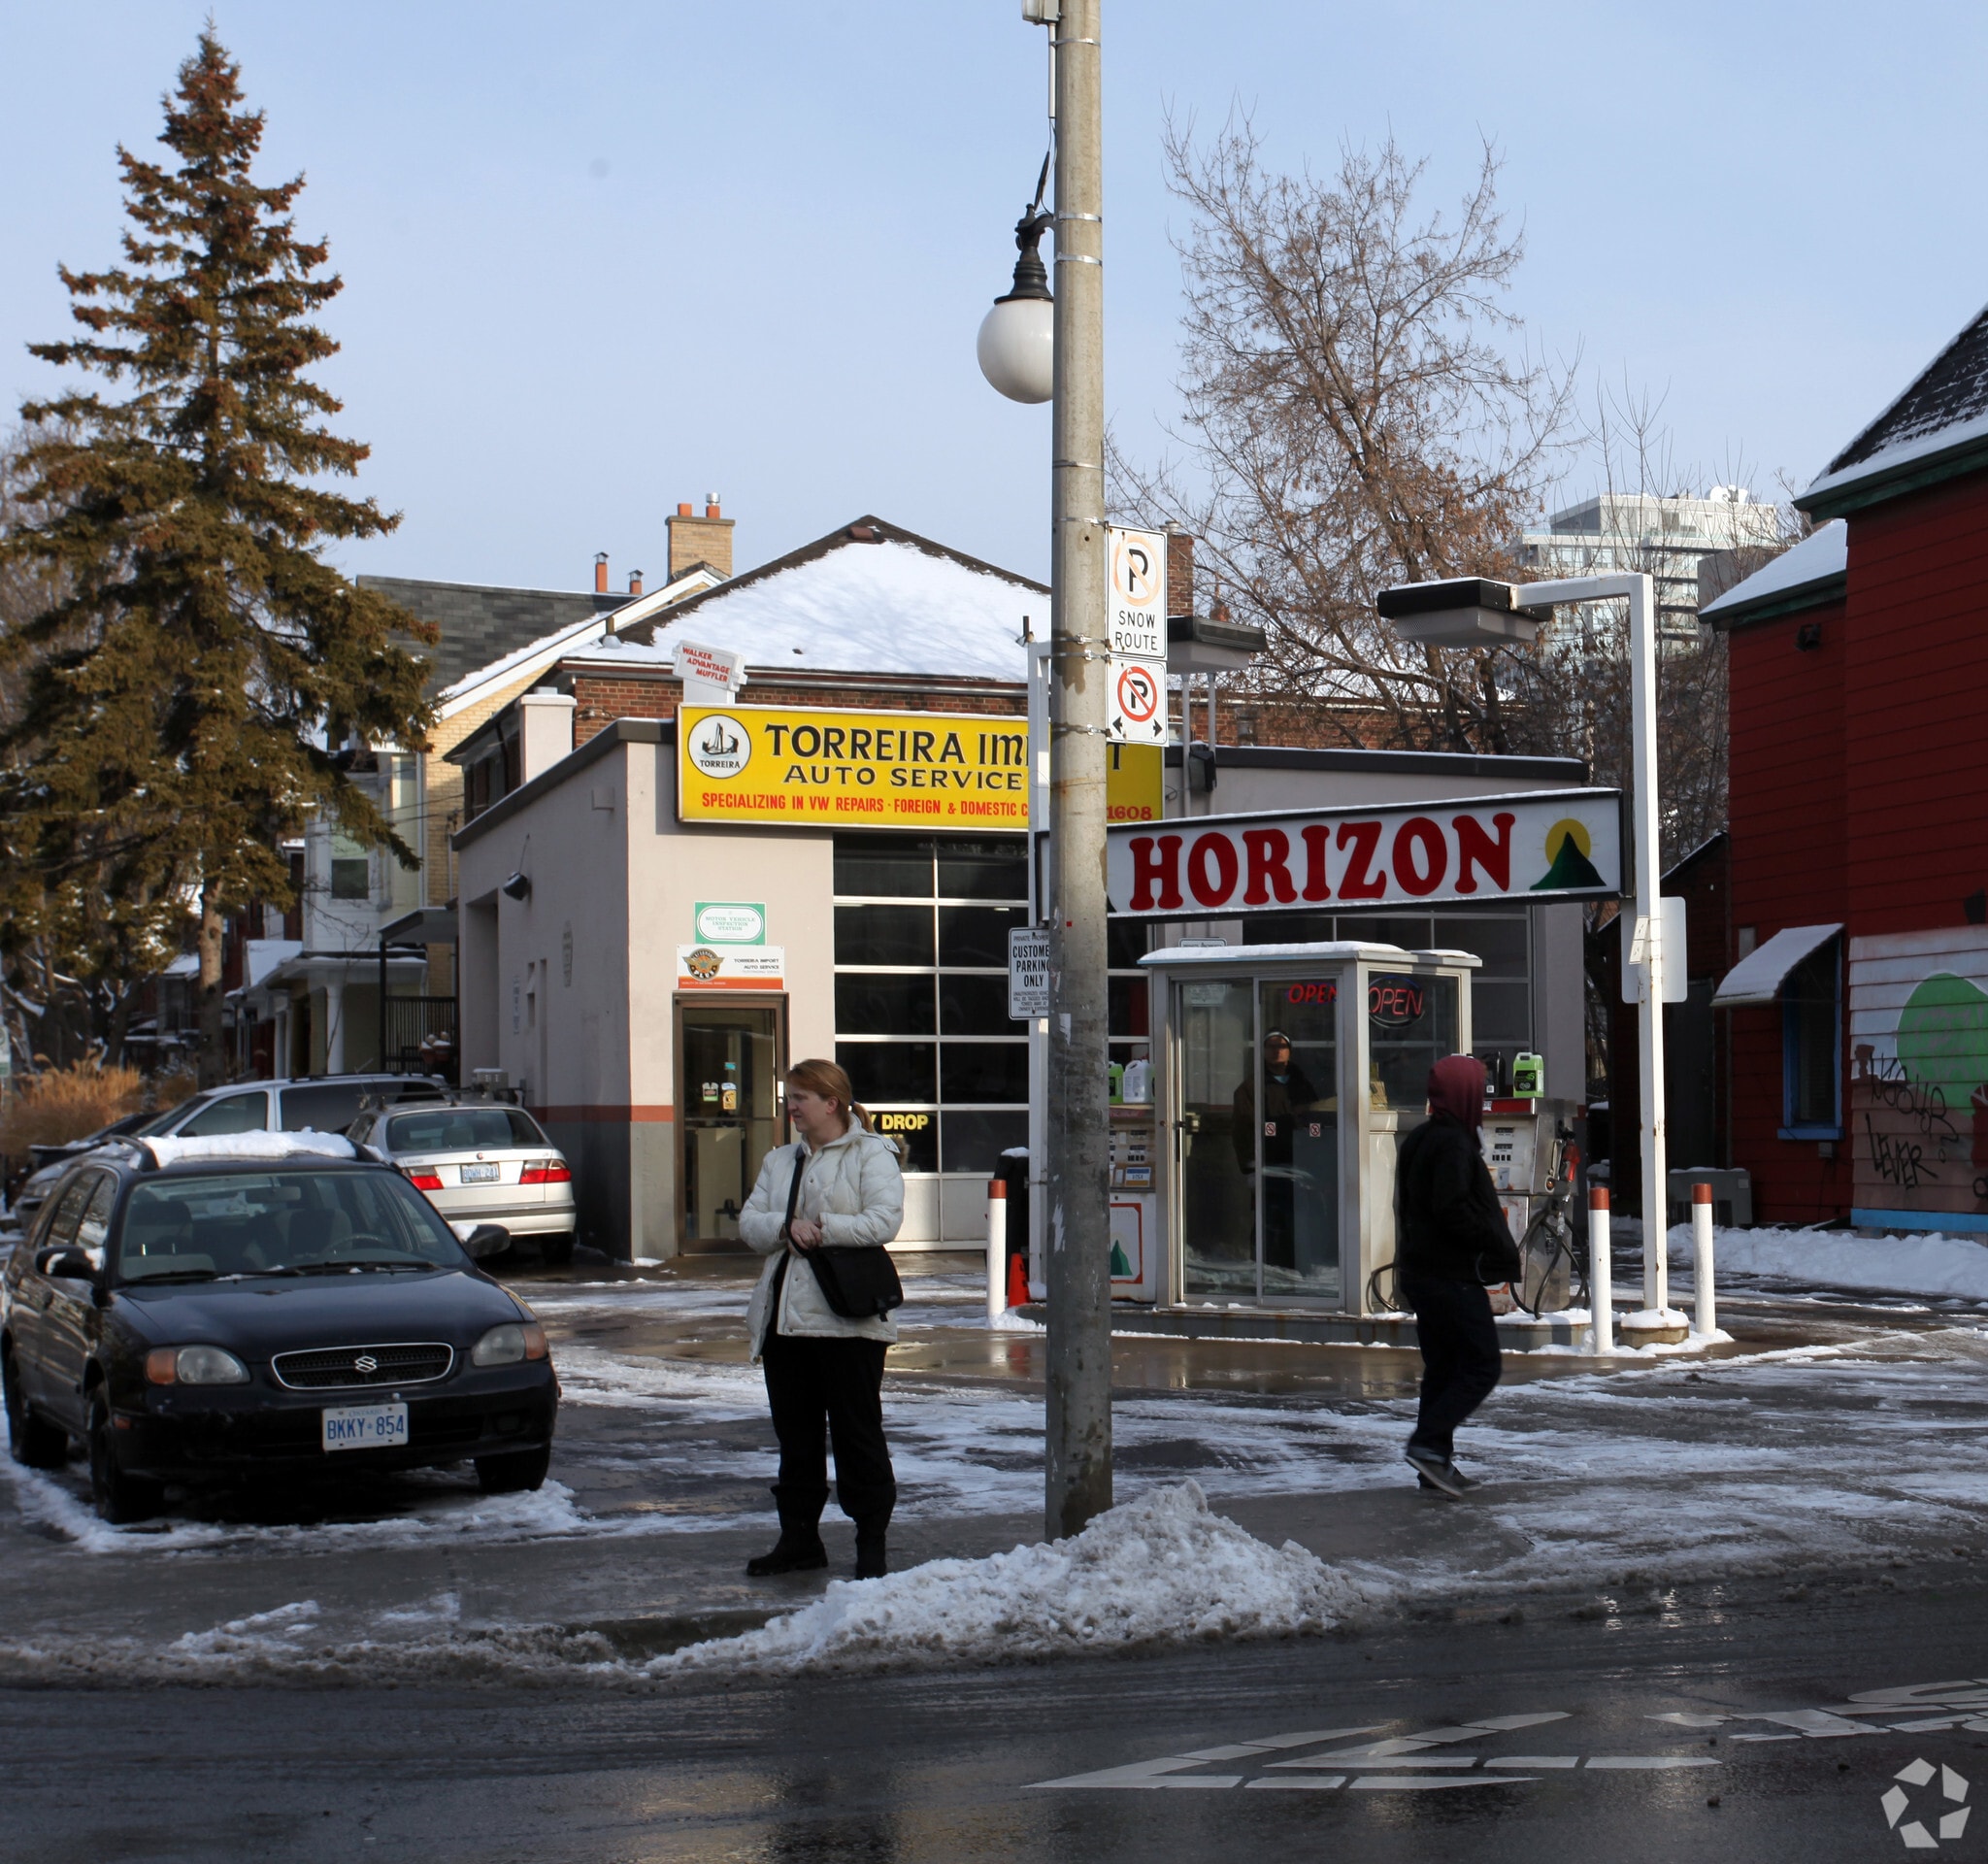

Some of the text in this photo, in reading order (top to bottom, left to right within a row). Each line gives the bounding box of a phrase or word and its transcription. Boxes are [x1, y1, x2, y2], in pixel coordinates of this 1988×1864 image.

[1118, 610, 1155, 629] SNOW
[1114, 631, 1158, 651] ROUTE
[682, 647, 712, 661] WALKER
[687, 657, 731, 675] ADVANTAGE
[696, 668, 728, 682] MUFFLER
[765, 723, 966, 764] TORREIRA
[700, 759, 741, 769] TORREIRA
[783, 765, 1022, 790] AUTO SERVICE
[702, 792, 786, 810] SPECIALIZING
[792, 795, 804, 810] IN
[810, 796, 829, 811] VW
[836, 797, 884, 813] REPAIRS
[894, 799, 941, 814] FOREIGN
[947, 802, 957, 815] &
[961, 801, 1017, 816] DOMESTIC
[1129, 813, 1515, 911] HORIZON
[1012, 945, 1049, 958] CUSTOME
[1024, 974, 1044, 987] ONLY
[1369, 986, 1423, 1015] OPEN
[881, 1114, 929, 1130] DROP
[327, 1415, 404, 1440] BKKY 854
